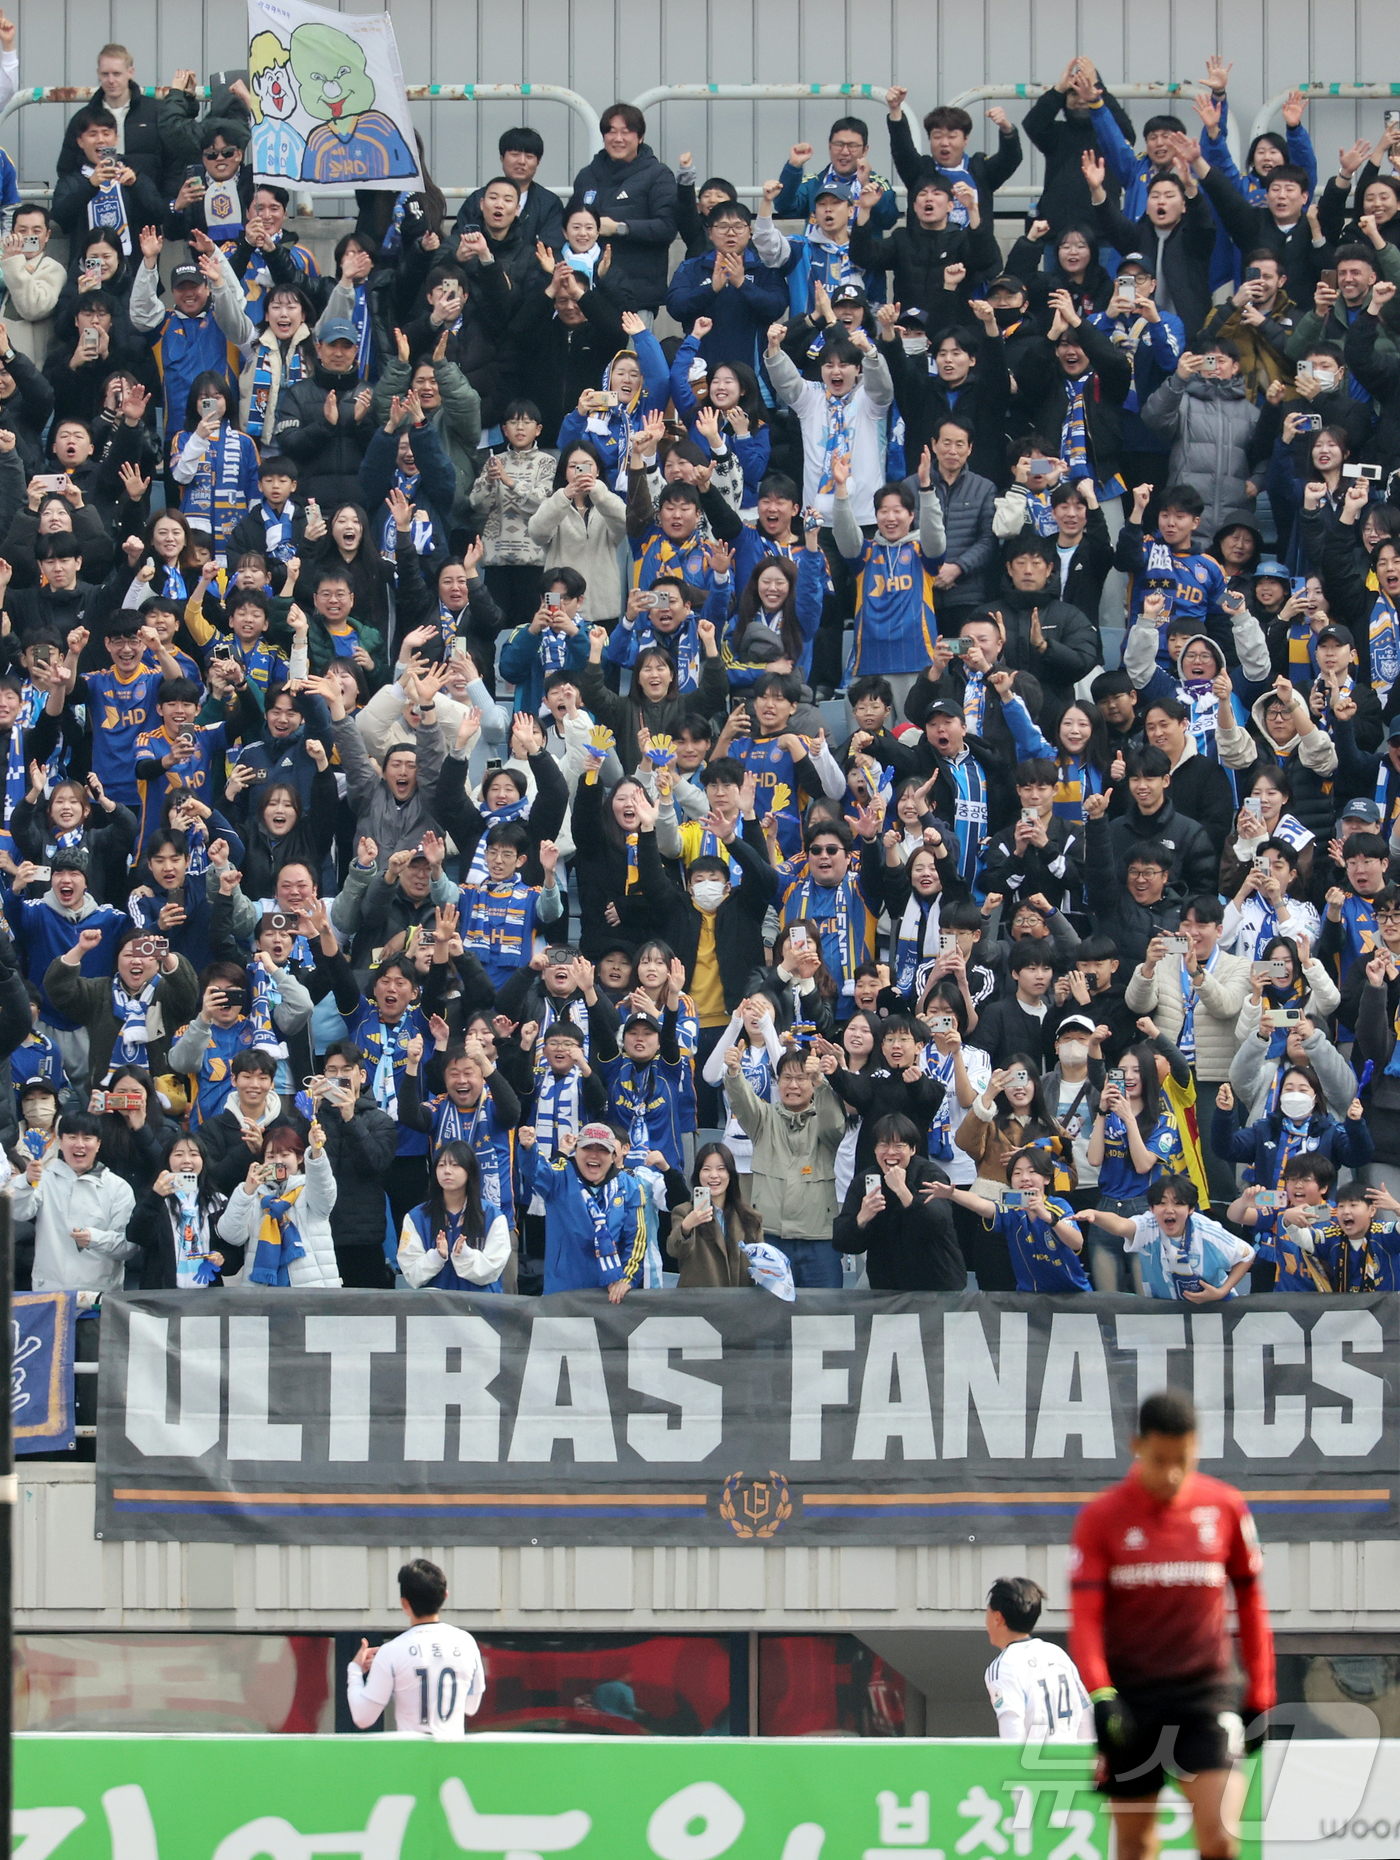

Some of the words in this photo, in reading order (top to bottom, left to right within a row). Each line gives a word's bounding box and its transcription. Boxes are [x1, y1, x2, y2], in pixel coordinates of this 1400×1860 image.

[887, 575, 913, 592] HD
[1176, 583, 1203, 604] HD
[122, 708, 147, 727] HD
[185, 770, 205, 789] HD
[754, 772, 777, 788] HD
[125, 1312, 723, 1463] ULTRAS
[789, 1309, 1385, 1461] FANATICS
[414, 1667, 458, 1726] 10
[1037, 1674, 1073, 1736] 14
